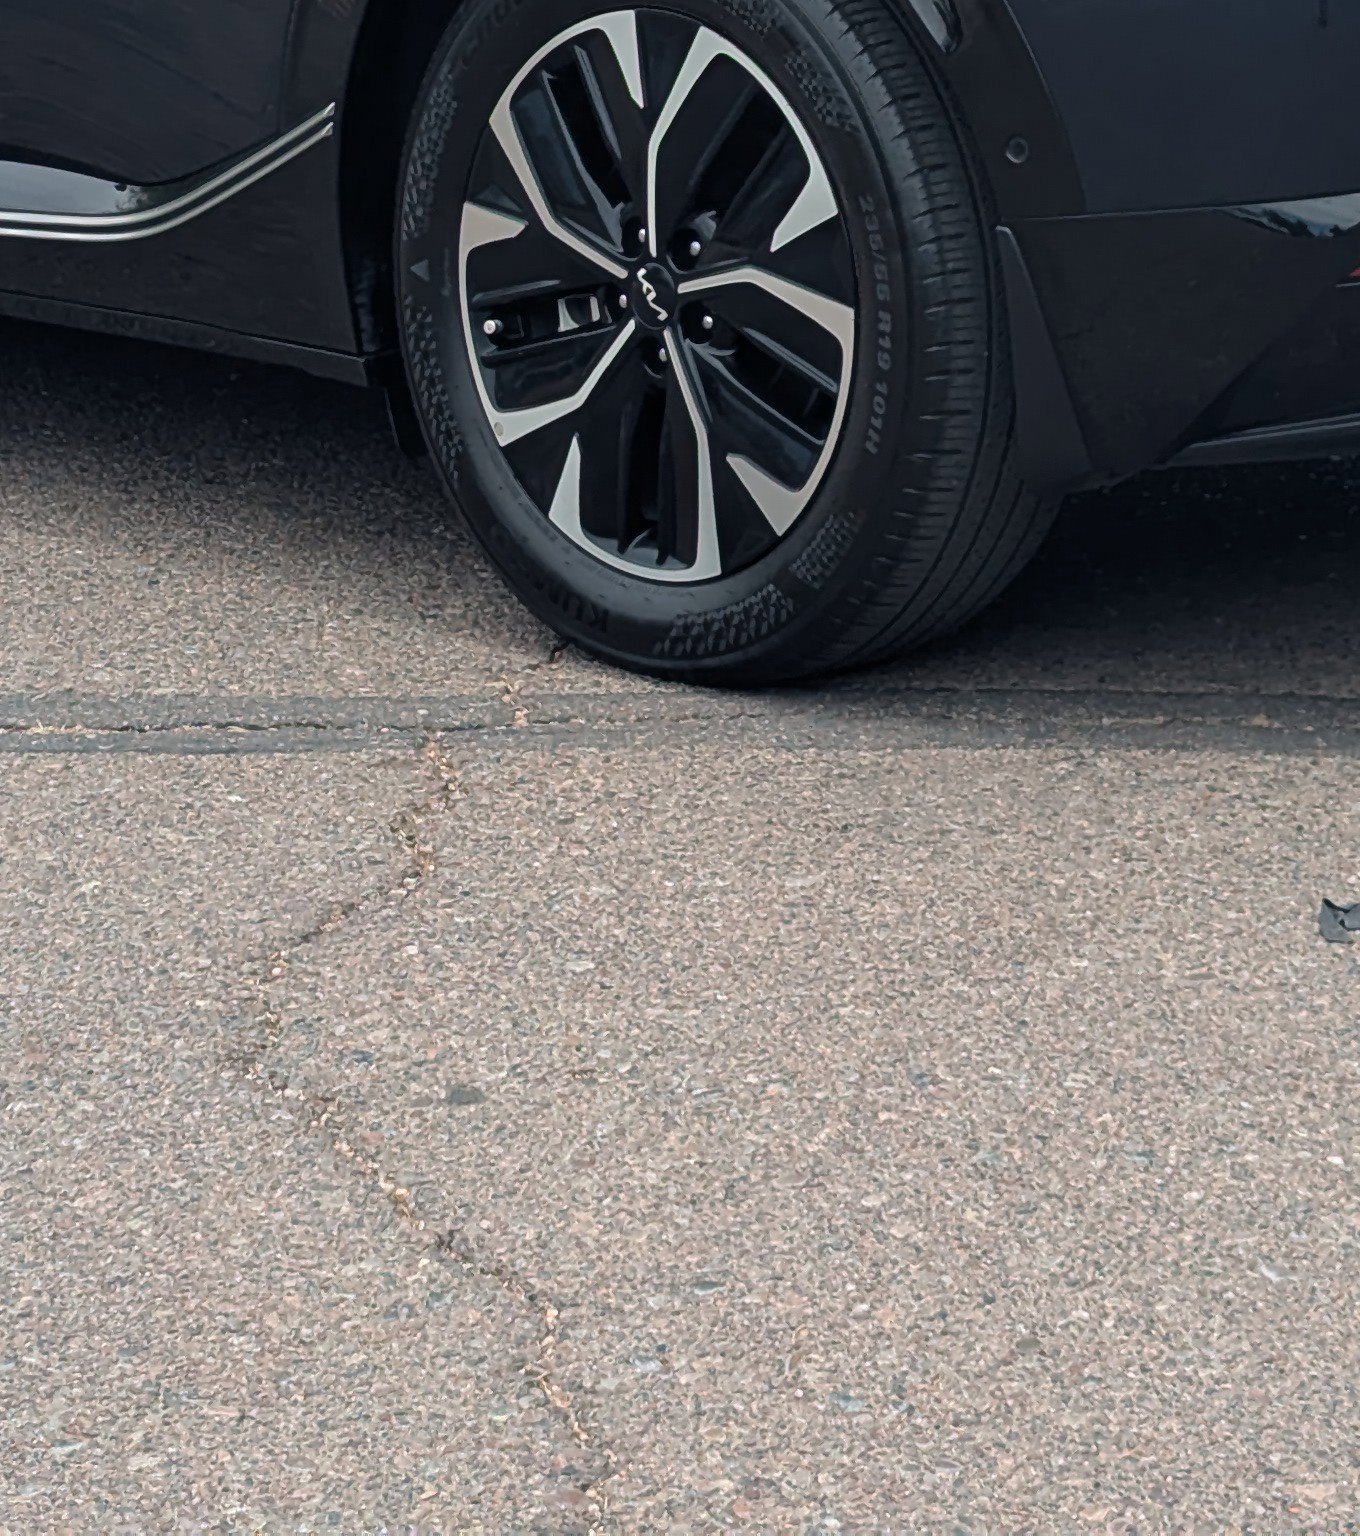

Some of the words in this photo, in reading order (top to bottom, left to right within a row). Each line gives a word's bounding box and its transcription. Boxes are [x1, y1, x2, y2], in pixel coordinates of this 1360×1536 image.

[859, 193, 891, 303] 235/55
[876, 309, 892, 372] R19
[864, 380, 889, 456] 101H
